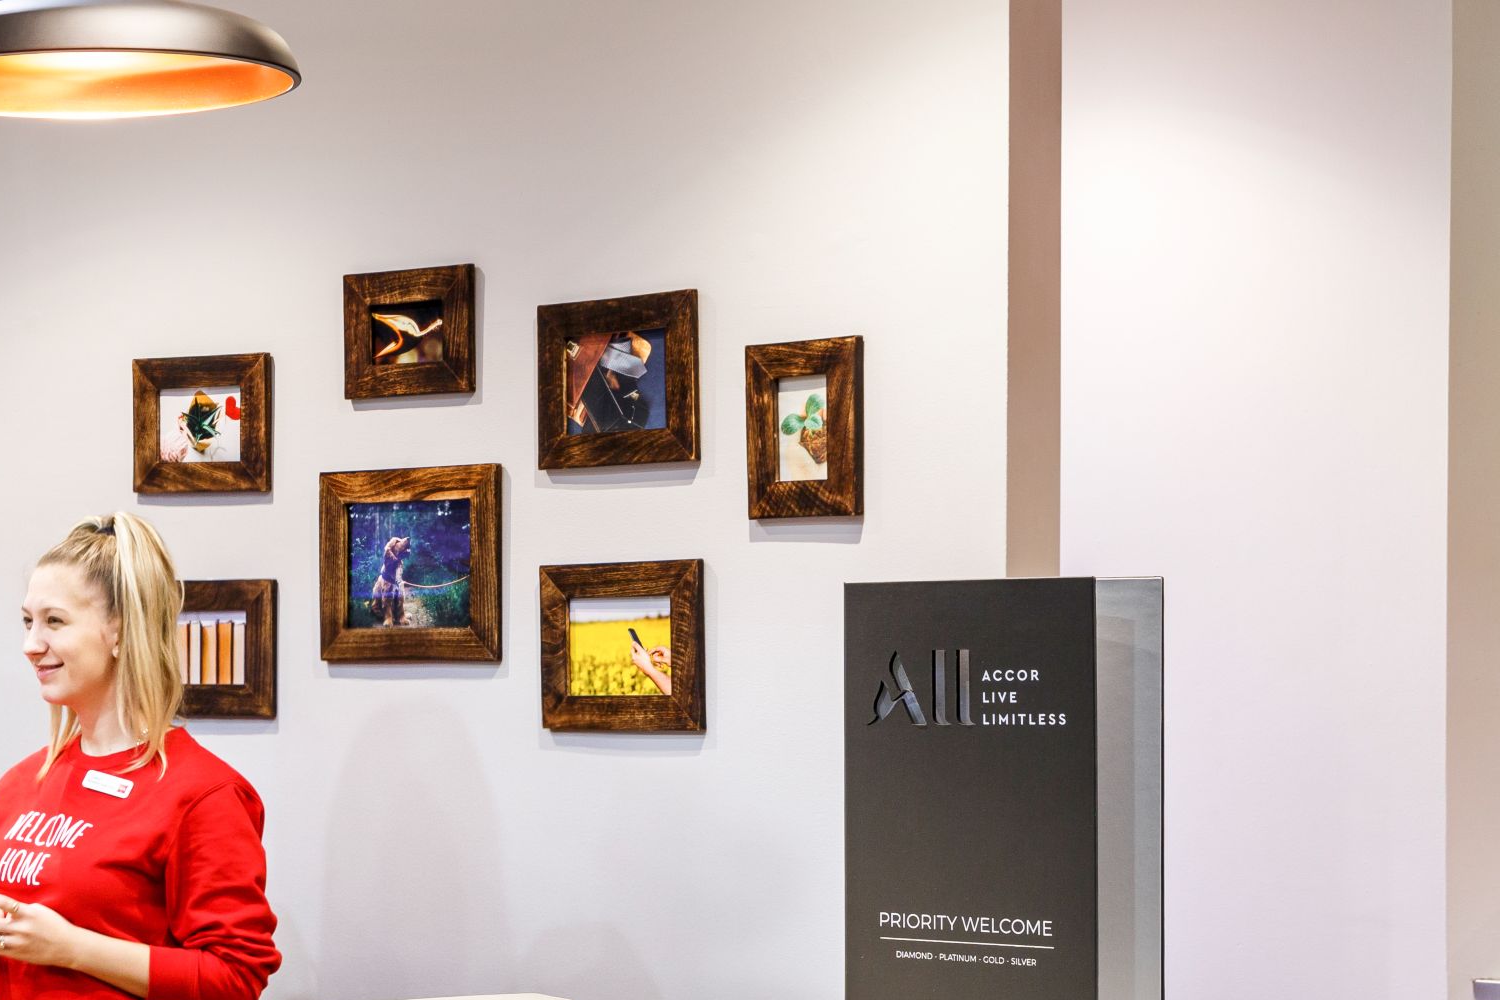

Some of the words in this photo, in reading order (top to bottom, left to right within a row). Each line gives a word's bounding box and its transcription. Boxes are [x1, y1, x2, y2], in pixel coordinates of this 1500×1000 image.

[981, 669, 1040, 682] ACCOR
[982, 691, 1018, 704] LIVE
[982, 713, 1068, 726] LIMITLESS
[879, 912, 957, 931] PRIORITY
[961, 916, 1052, 936] WELCOME
[896, 950, 933, 960] DIAMOND
[939, 953, 977, 963] PLATINUM
[983, 956, 1005, 965] GOLD
[1010, 957, 1036, 966] SILVER
